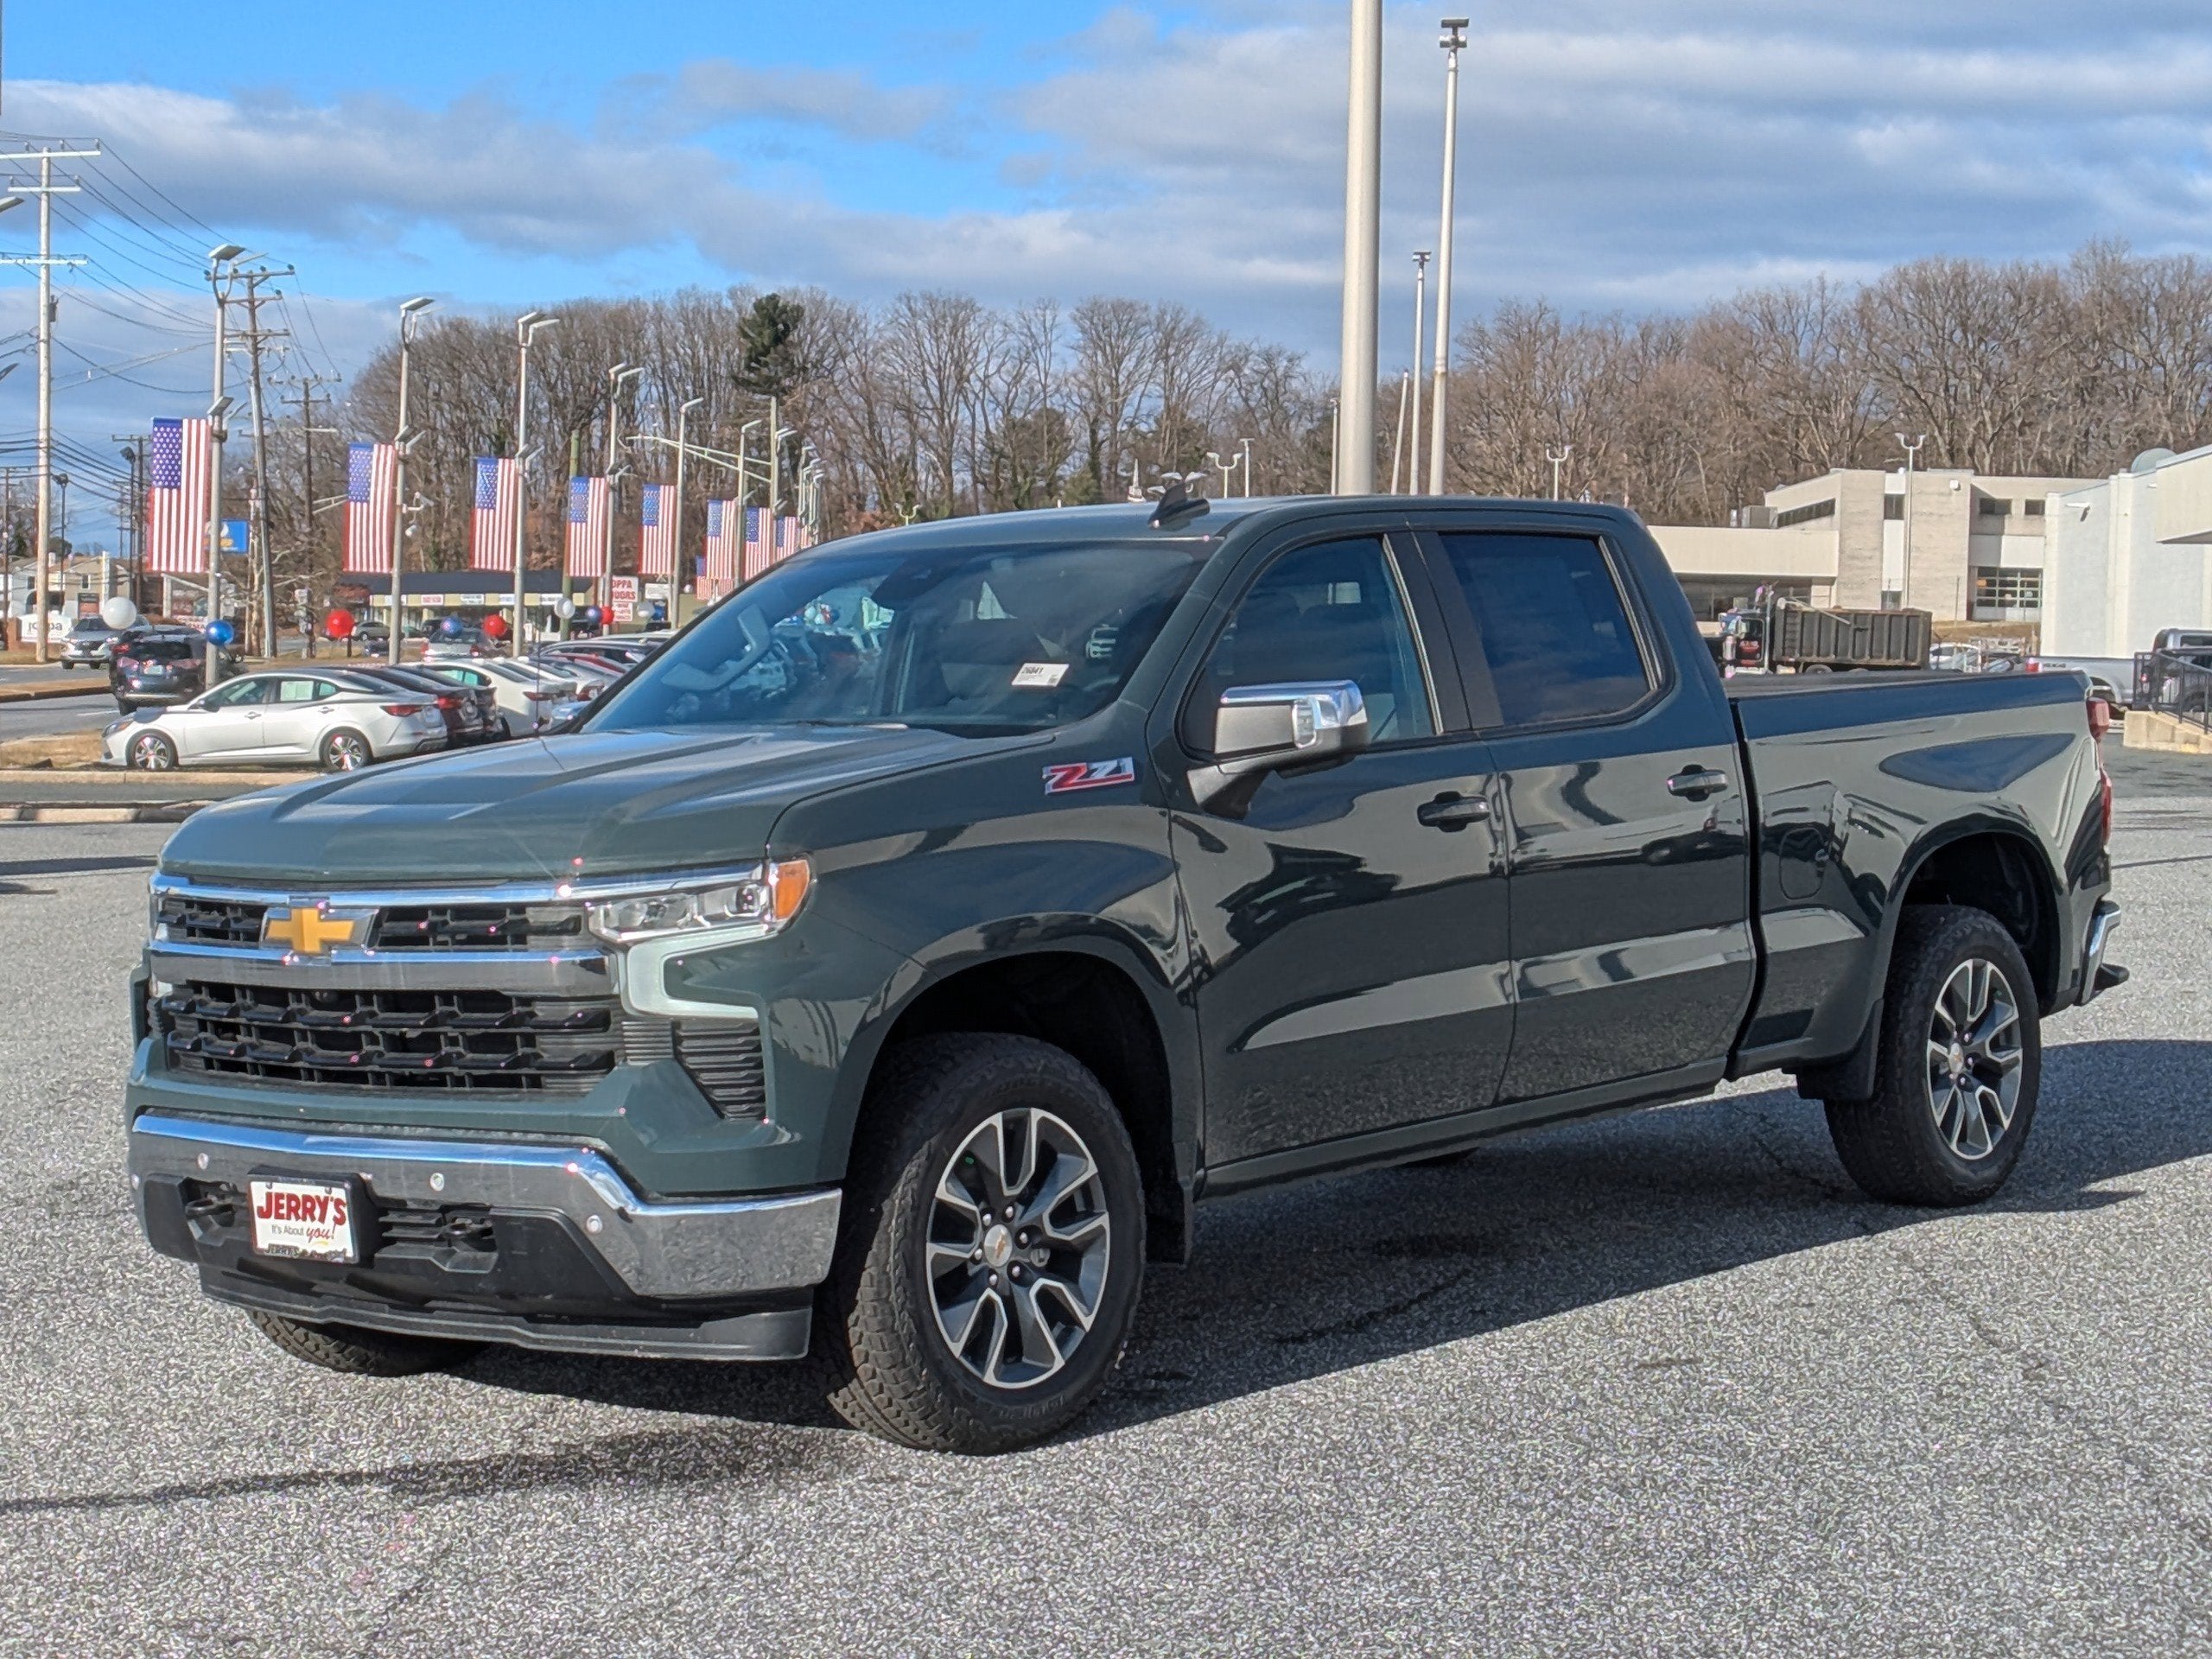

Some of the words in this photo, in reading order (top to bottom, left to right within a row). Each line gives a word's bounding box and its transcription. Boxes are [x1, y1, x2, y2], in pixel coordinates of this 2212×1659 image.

[1042, 757, 1135, 794] Z71
[257, 1192, 347, 1225] JERRY'S
[272, 1224, 282, 1234] It's
[306, 1224, 336, 1243] you!
